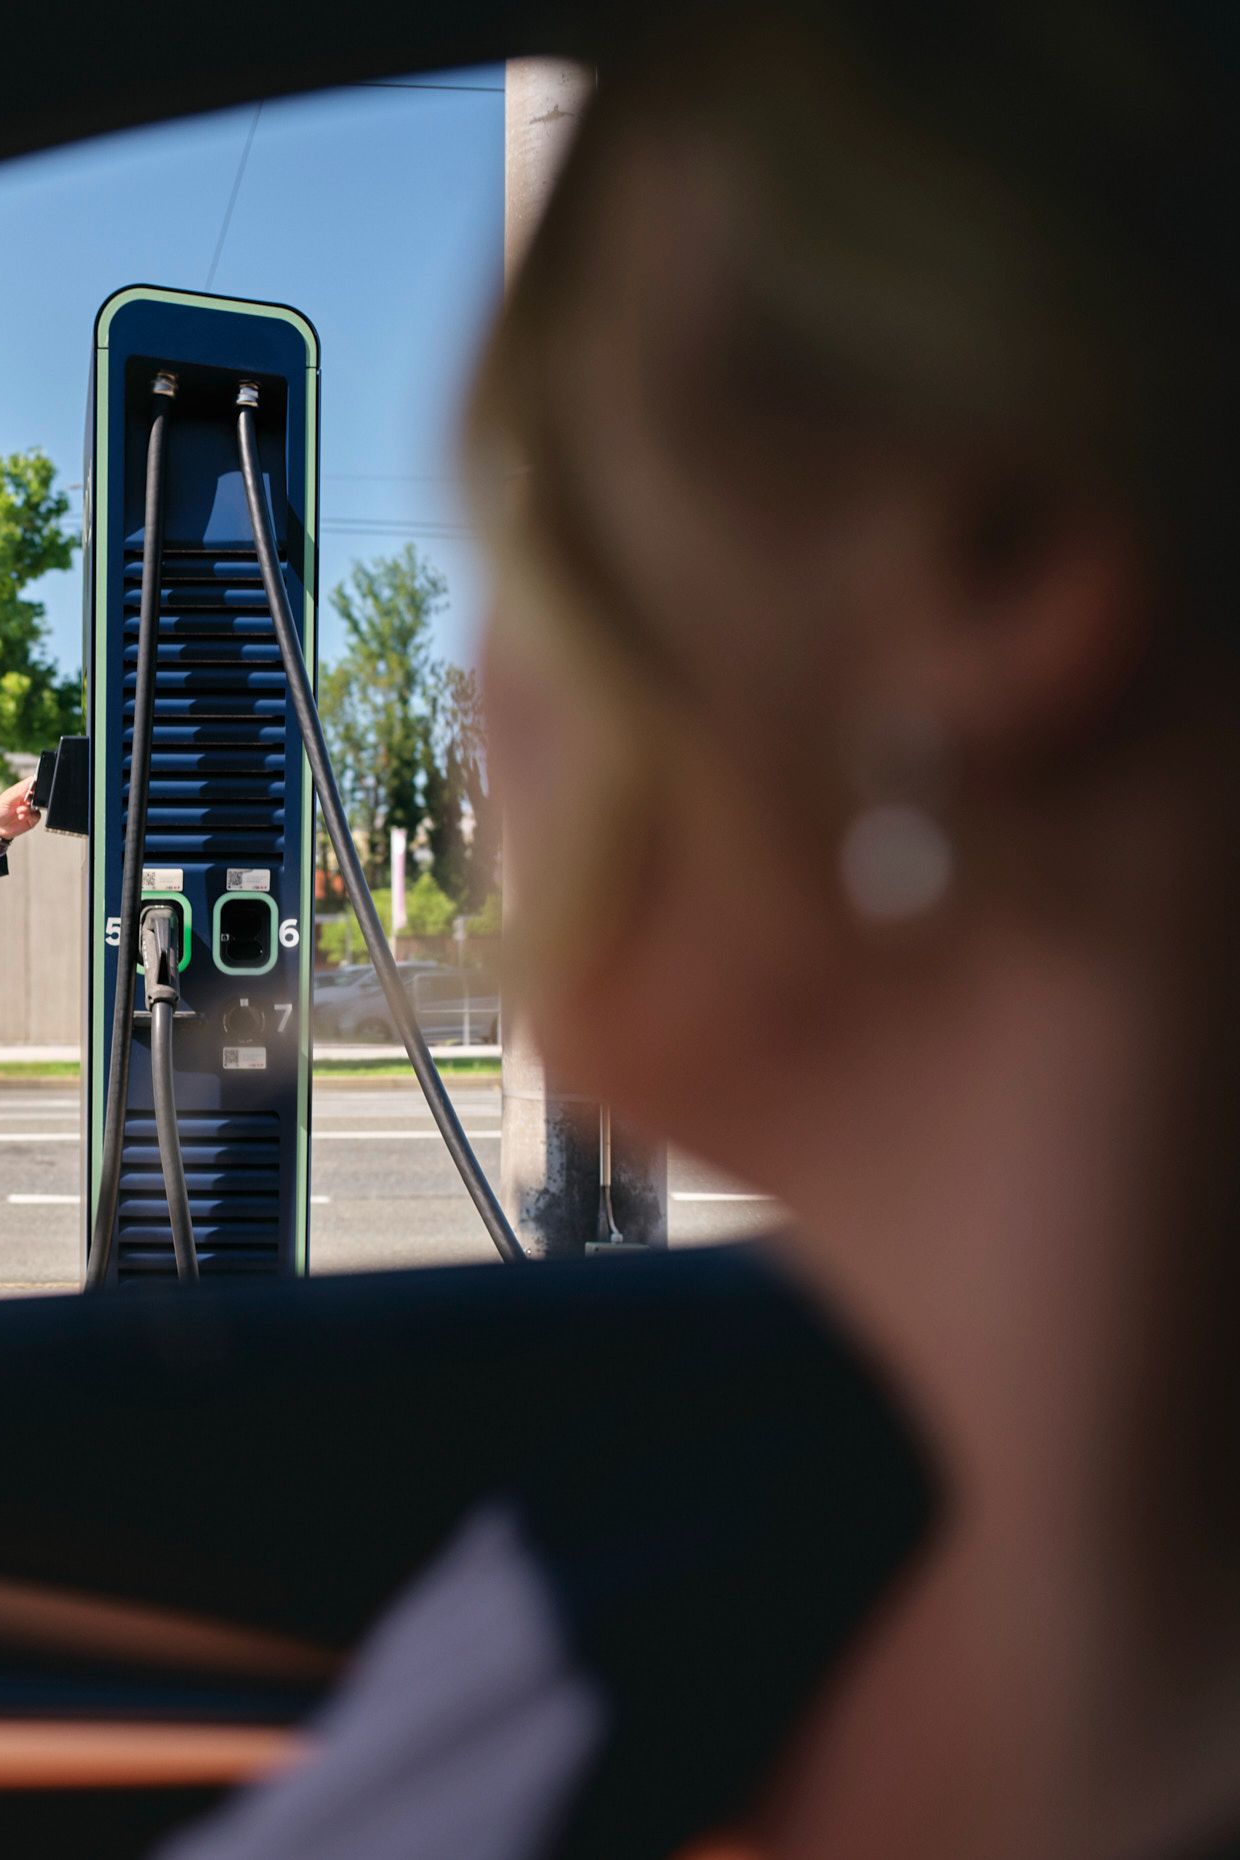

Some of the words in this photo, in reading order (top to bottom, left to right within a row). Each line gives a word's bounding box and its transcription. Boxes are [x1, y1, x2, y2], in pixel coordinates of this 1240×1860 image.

[105, 917, 121, 946] 5
[279, 919, 300, 948] 6
[274, 1004, 293, 1032] 7
